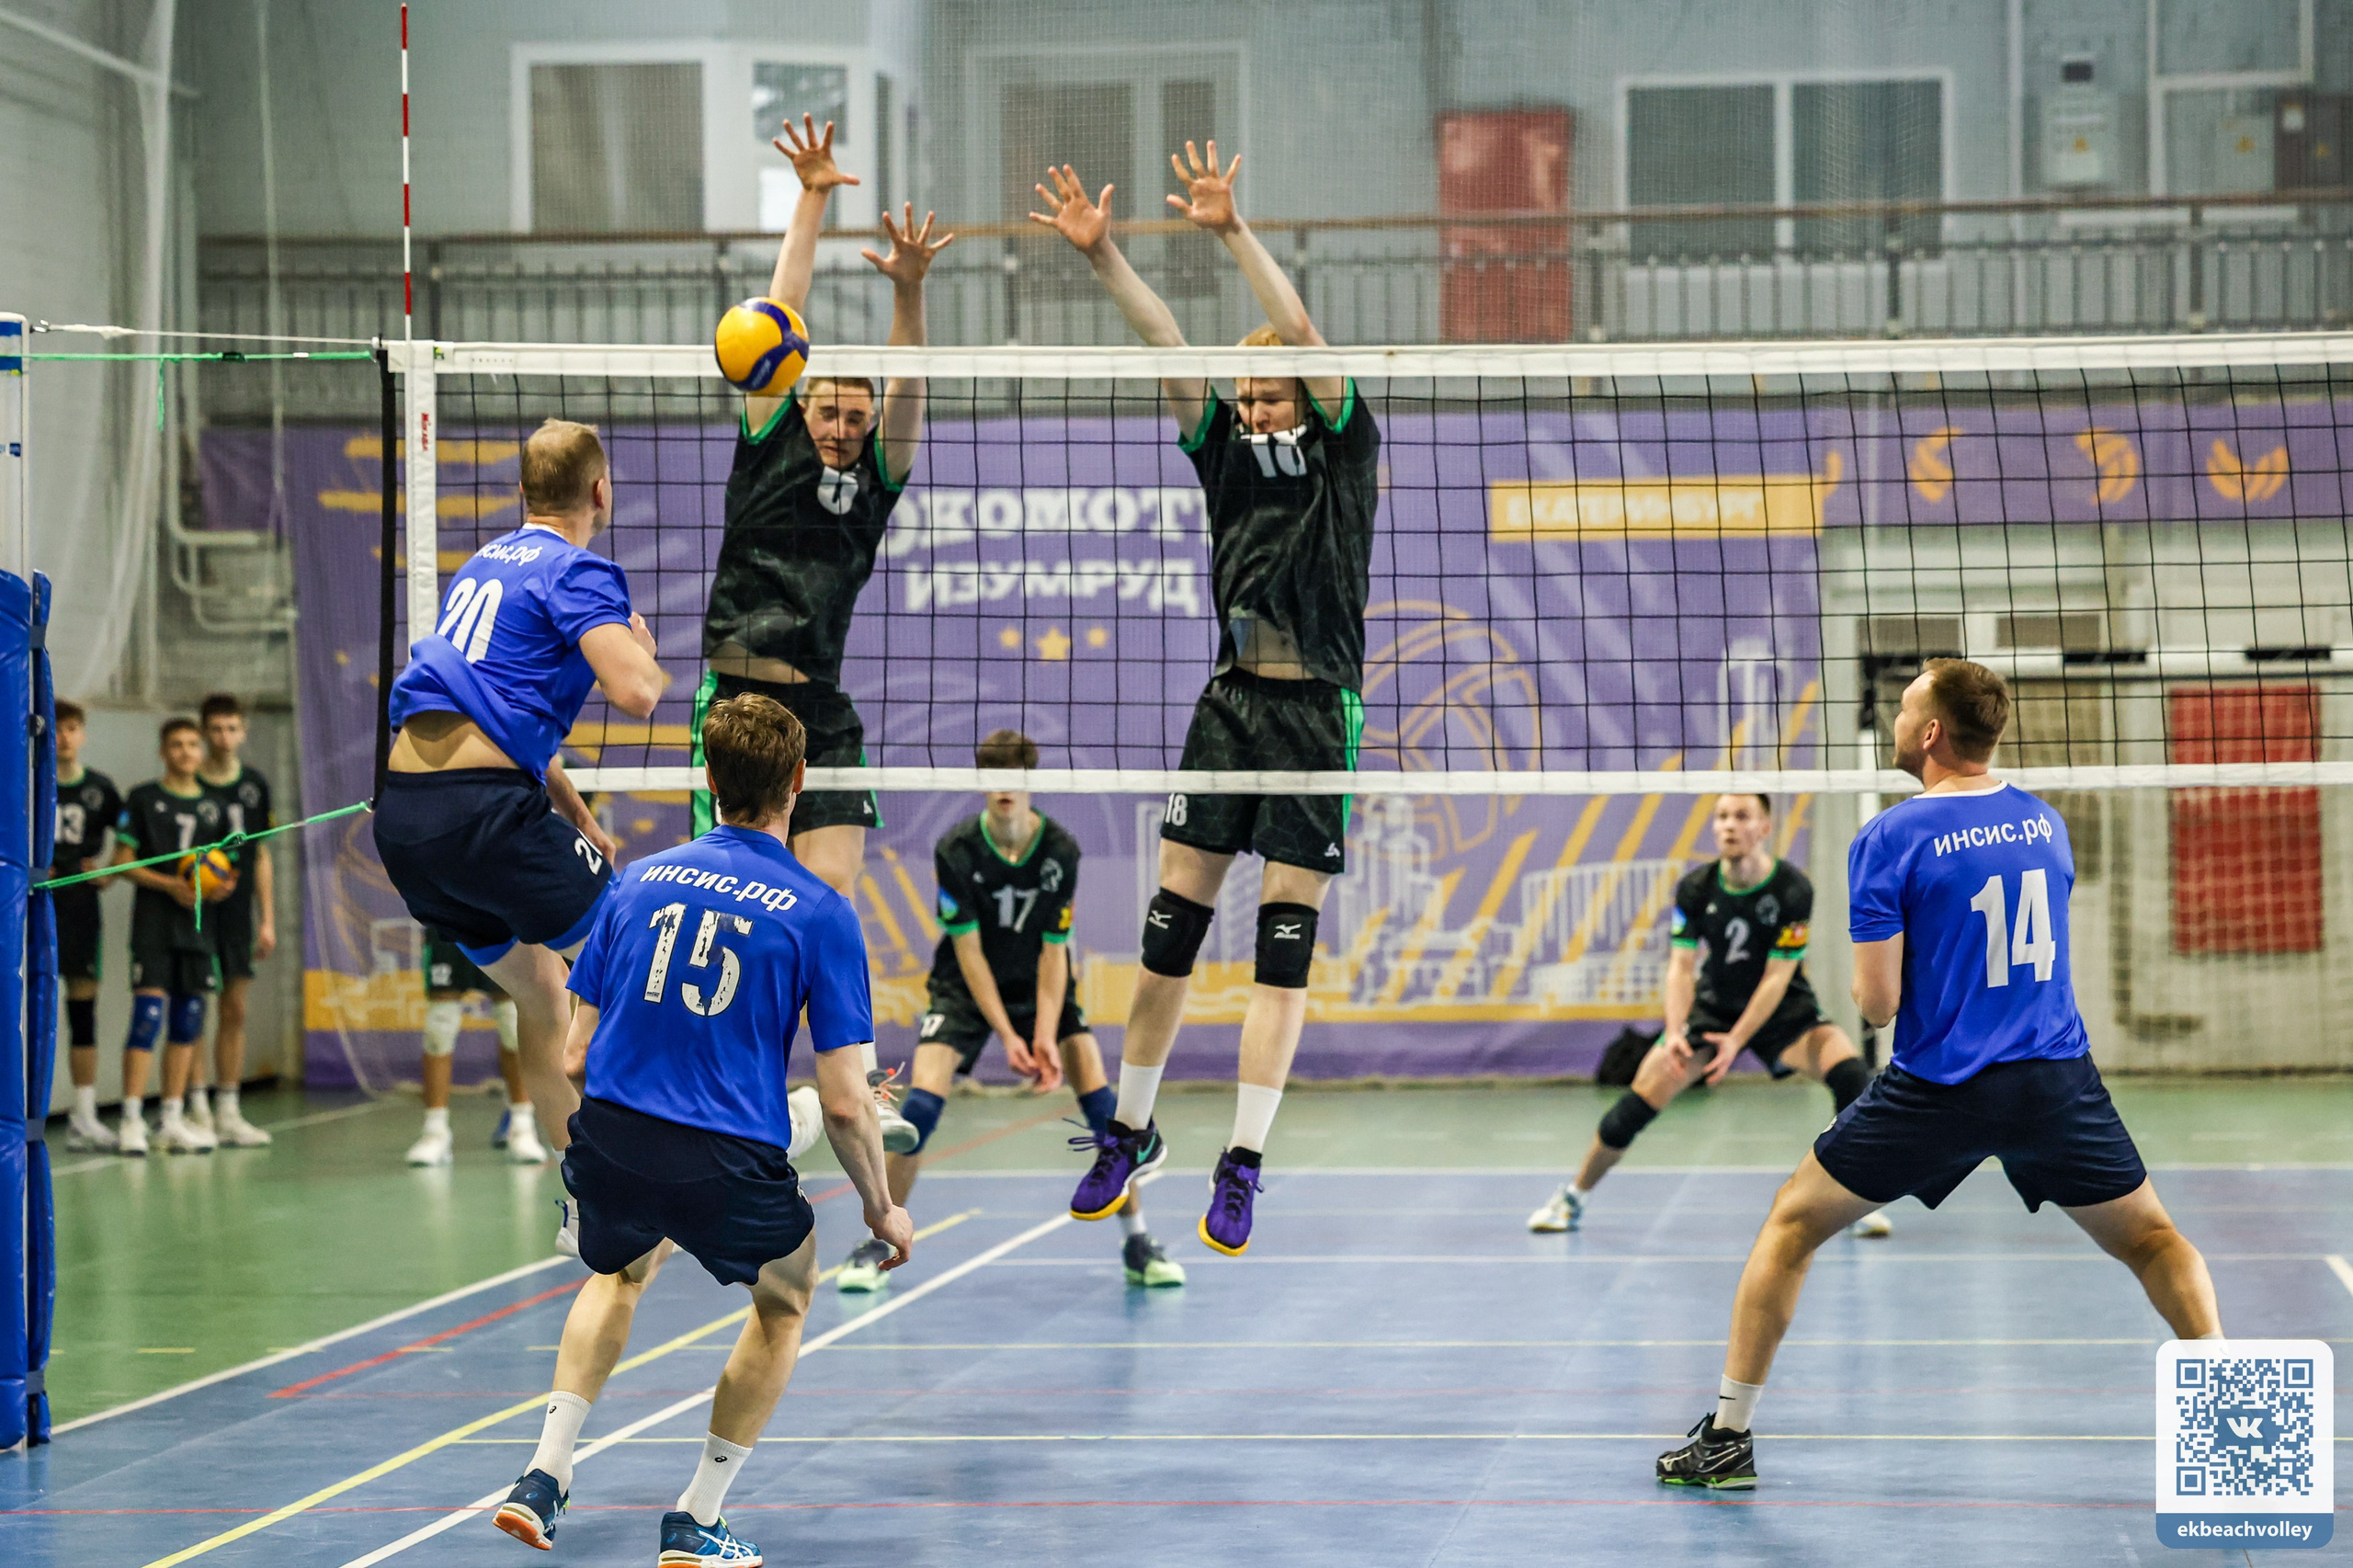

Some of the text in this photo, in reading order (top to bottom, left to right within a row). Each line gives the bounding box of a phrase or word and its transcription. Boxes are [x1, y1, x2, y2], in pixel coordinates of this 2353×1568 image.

[905, 559, 1199, 618] ИЗУМРУД
[437, 577, 503, 665] 20
[175, 812, 198, 851] 7
[1165, 792, 1188, 826] 18
[1934, 813, 2052, 857] инсис.рф
[640, 865, 798, 912] инсис.рф
[992, 884, 1040, 933] 17
[1724, 917, 1750, 964] 2
[1970, 869, 2055, 988] 14
[644, 902, 754, 1017] 15
